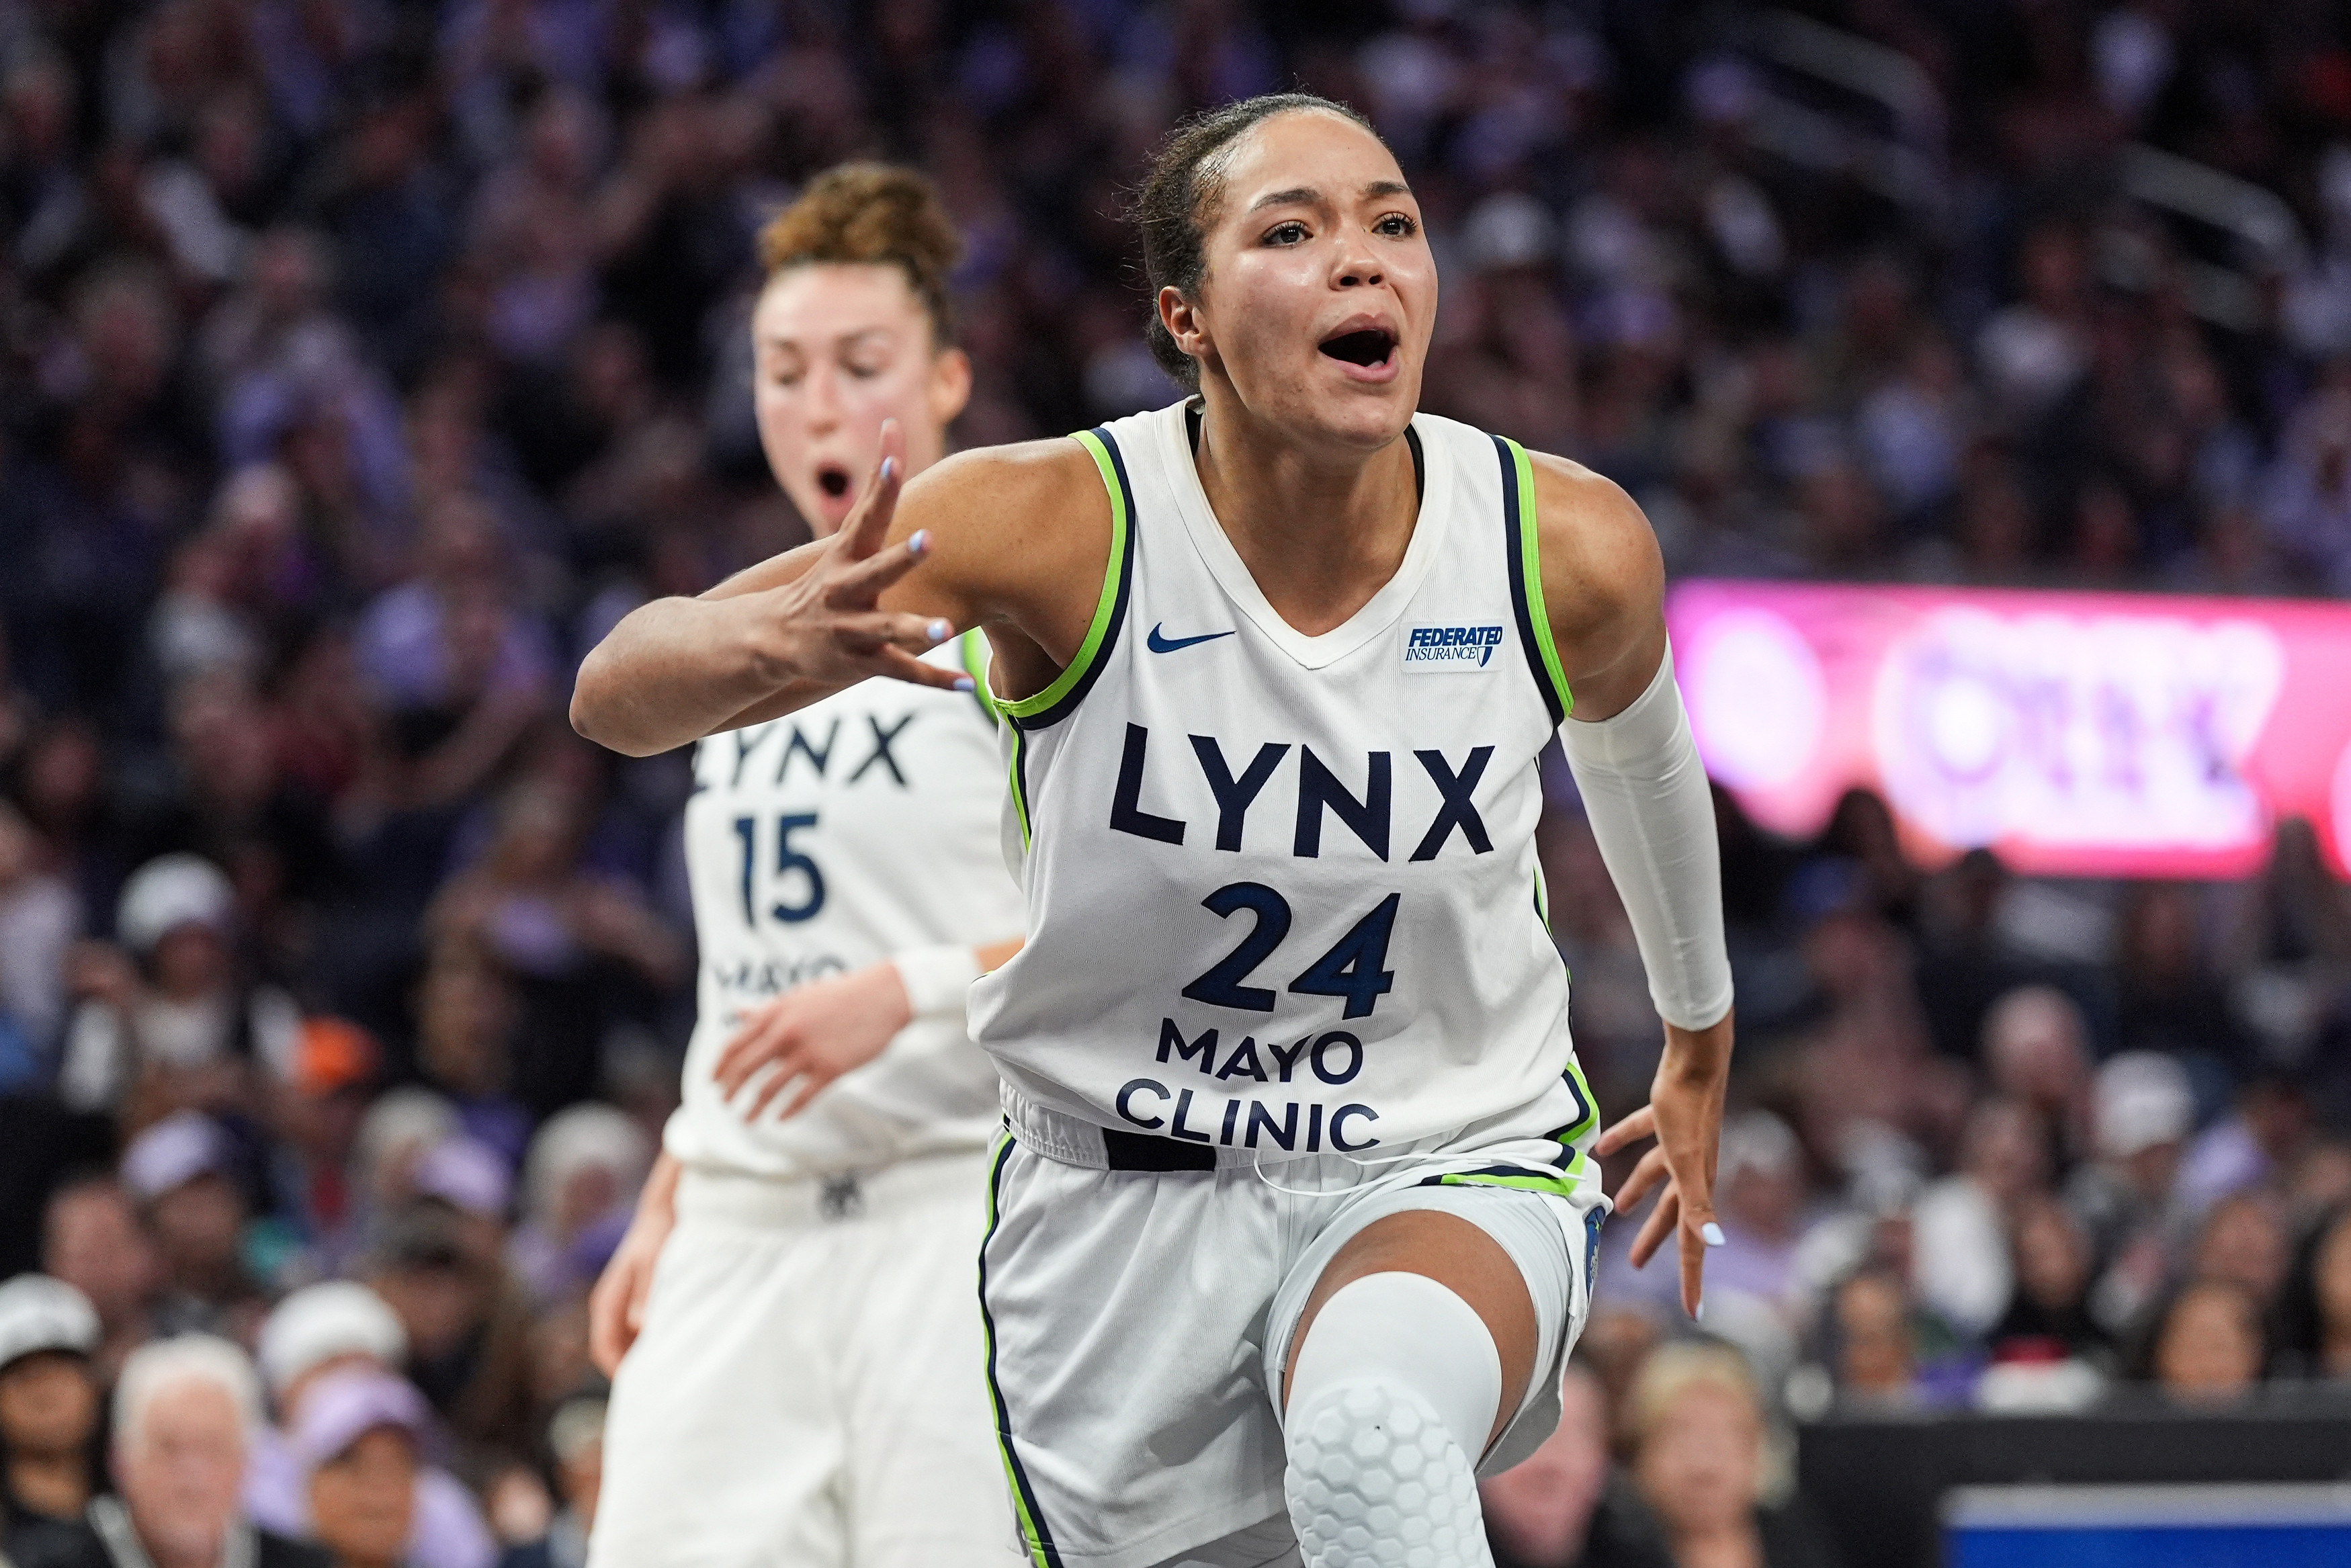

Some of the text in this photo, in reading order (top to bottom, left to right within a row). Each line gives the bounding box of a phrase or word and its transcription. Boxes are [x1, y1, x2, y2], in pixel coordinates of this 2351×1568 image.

[1405, 646, 1478, 661] INSURANCE
[1408, 626, 1503, 647] FEDERATED
[1109, 722, 1496, 863] LYNX
[732, 811, 829, 927] 15
[1181, 881, 1402, 1021] 24
[1155, 1017, 1363, 1085] MAYO
[1115, 1078, 1381, 1153] CLINIC
